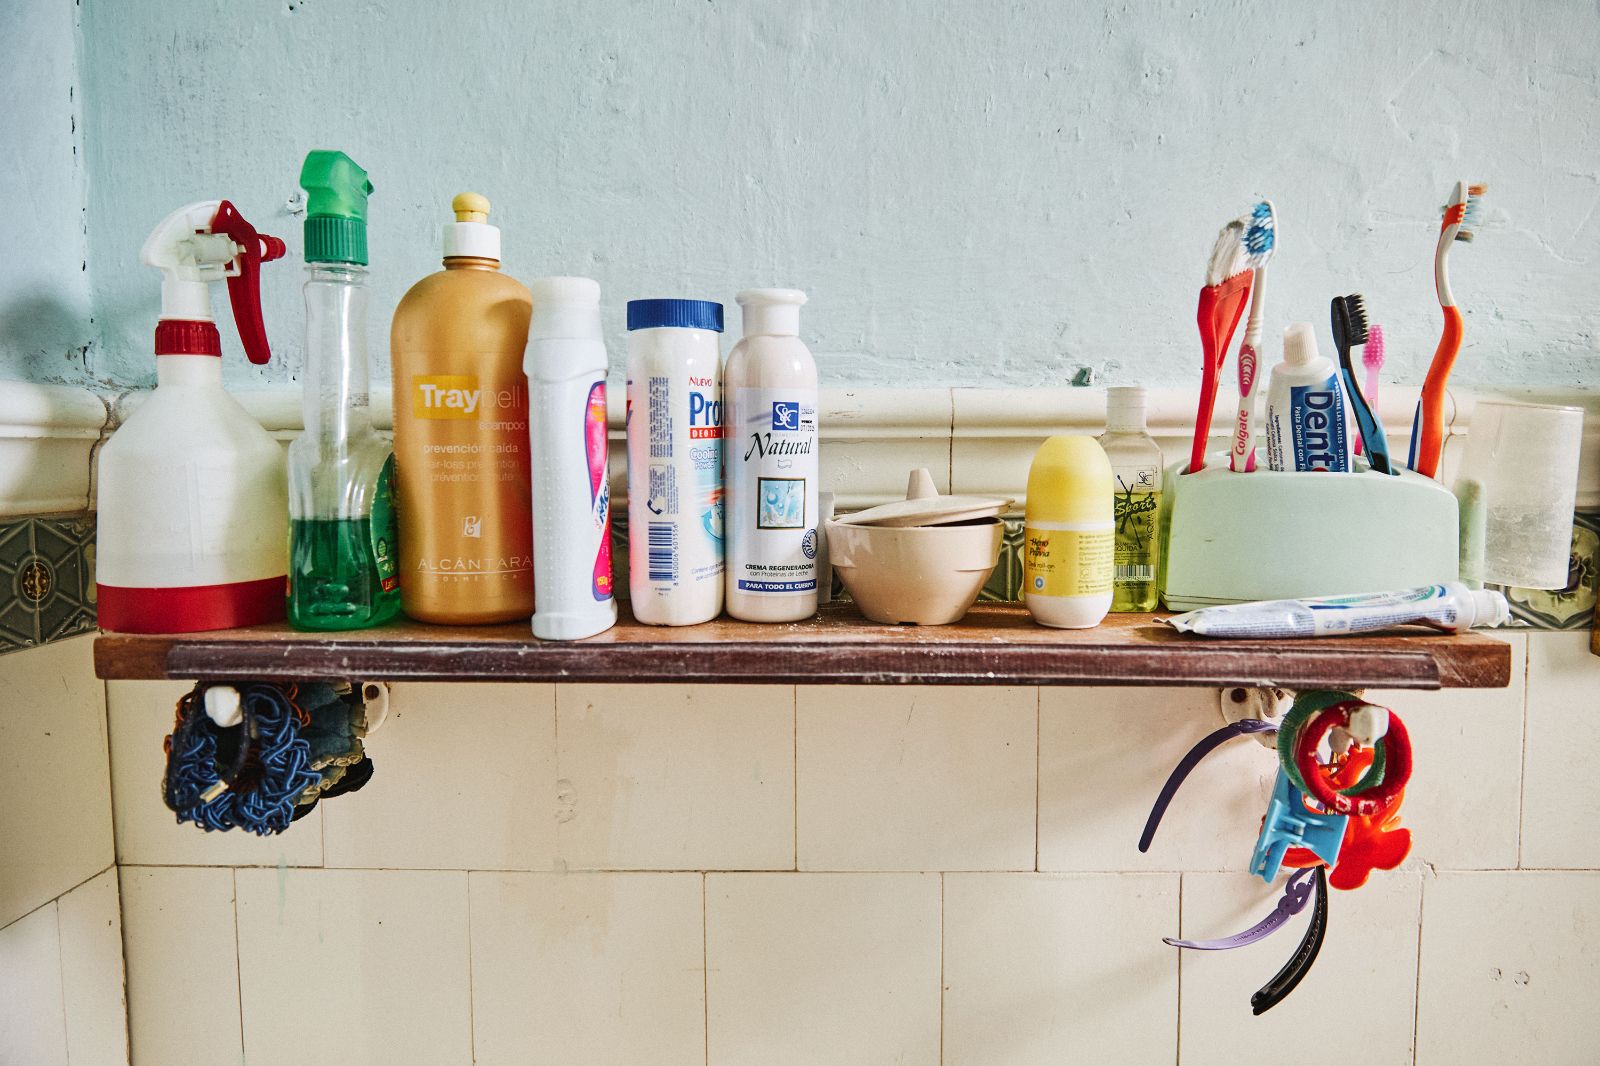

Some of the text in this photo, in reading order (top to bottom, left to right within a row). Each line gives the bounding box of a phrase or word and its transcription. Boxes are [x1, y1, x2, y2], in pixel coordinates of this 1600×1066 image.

[689, 377, 712, 387] NUEVO
[689, 391, 722, 426] Pro
[1235, 409, 1249, 456] Colgate
[1296, 425, 1304, 447] Dental
[1303, 390, 1337, 472] Dent
[745, 432, 813, 462] Natural
[1115, 498, 1153, 516] Sport
[417, 556, 533, 571] ALCÁNTARA
[745, 563, 814, 571] CREMA REGENERADORA
[795, 581, 814, 589] CUERPO
